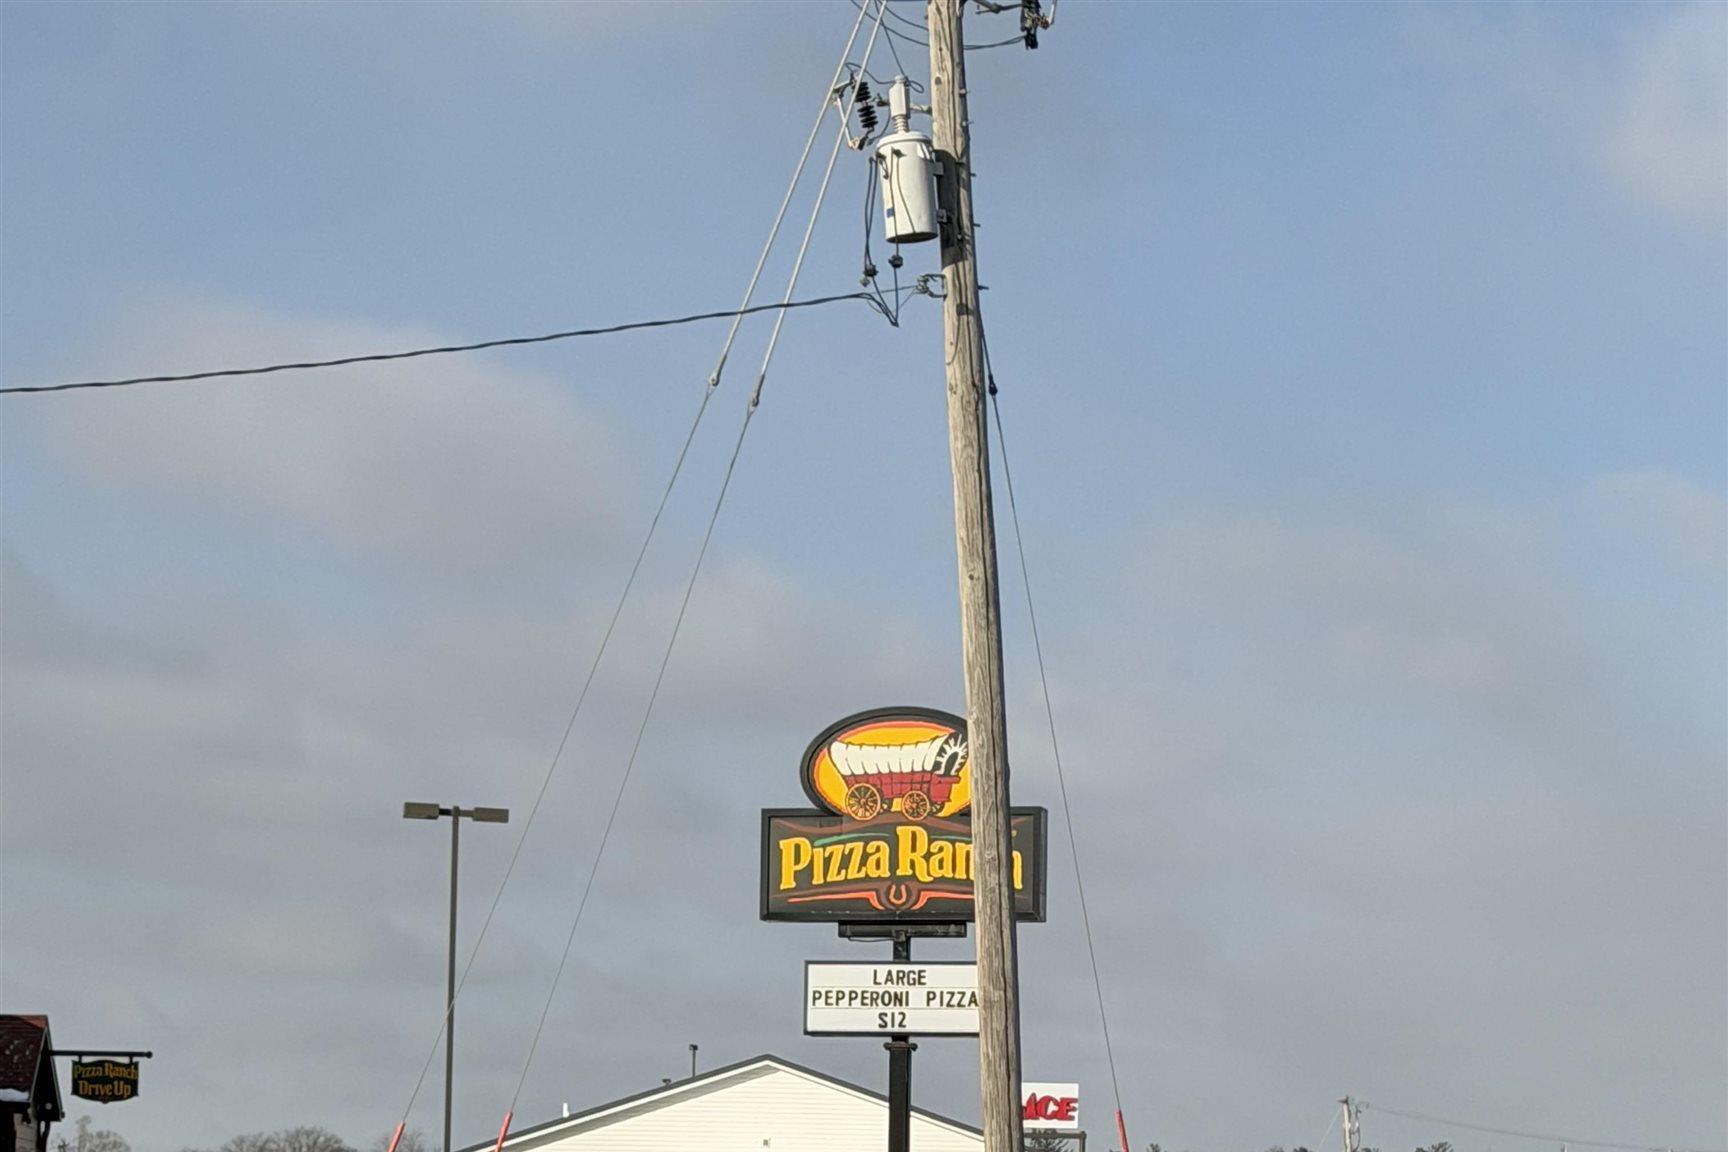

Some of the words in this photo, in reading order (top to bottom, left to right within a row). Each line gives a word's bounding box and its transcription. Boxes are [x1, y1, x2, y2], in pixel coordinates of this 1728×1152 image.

[779, 837, 890, 889] Pizza
[873, 969, 926, 985] LARGE
[812, 990, 909, 1007] PEPPERONI
[926, 991, 978, 1007] PIZZA
[75, 1065, 102, 1077] Pizza
[105, 1063, 137, 1079] Ranch
[79, 1081, 112, 1095] Drive
[114, 1081, 131, 1097] Up
